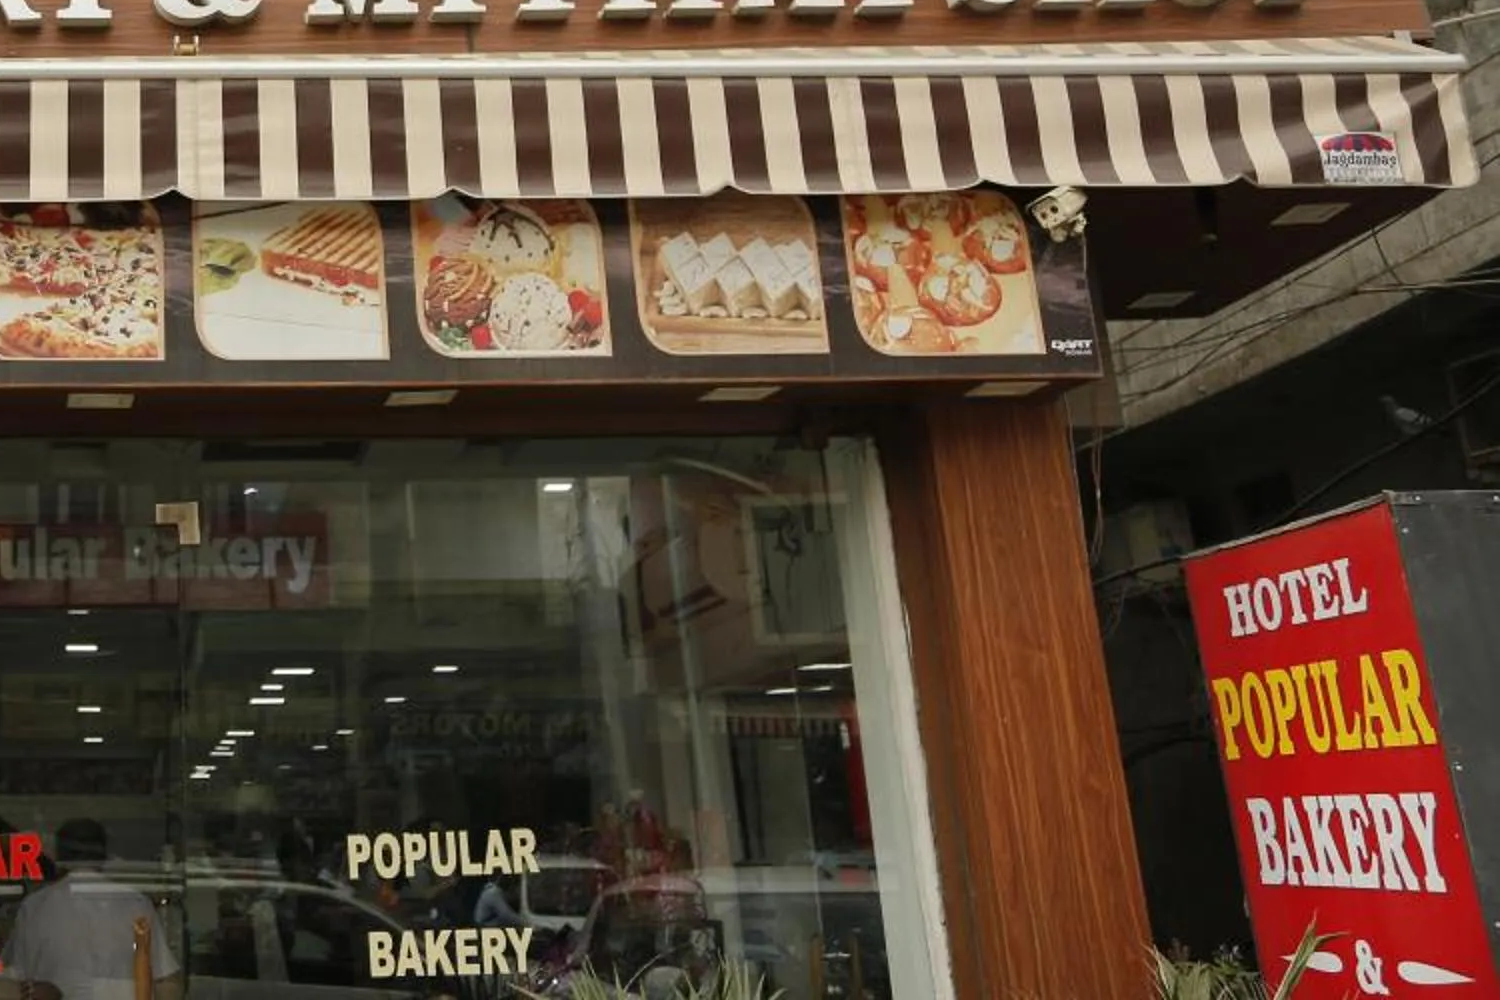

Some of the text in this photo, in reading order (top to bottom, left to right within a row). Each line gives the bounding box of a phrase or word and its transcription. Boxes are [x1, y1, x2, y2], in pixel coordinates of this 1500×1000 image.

[124, 525, 317, 595] Bakery
[1222, 557, 1369, 638] HOTEL
[1212, 648, 1437, 761] POPULAR
[346, 828, 540, 880] POPULAR
[1246, 792, 1447, 893] BAKERY
[368, 927, 534, 977] BAKERY
[1354, 939, 1391, 996] &
